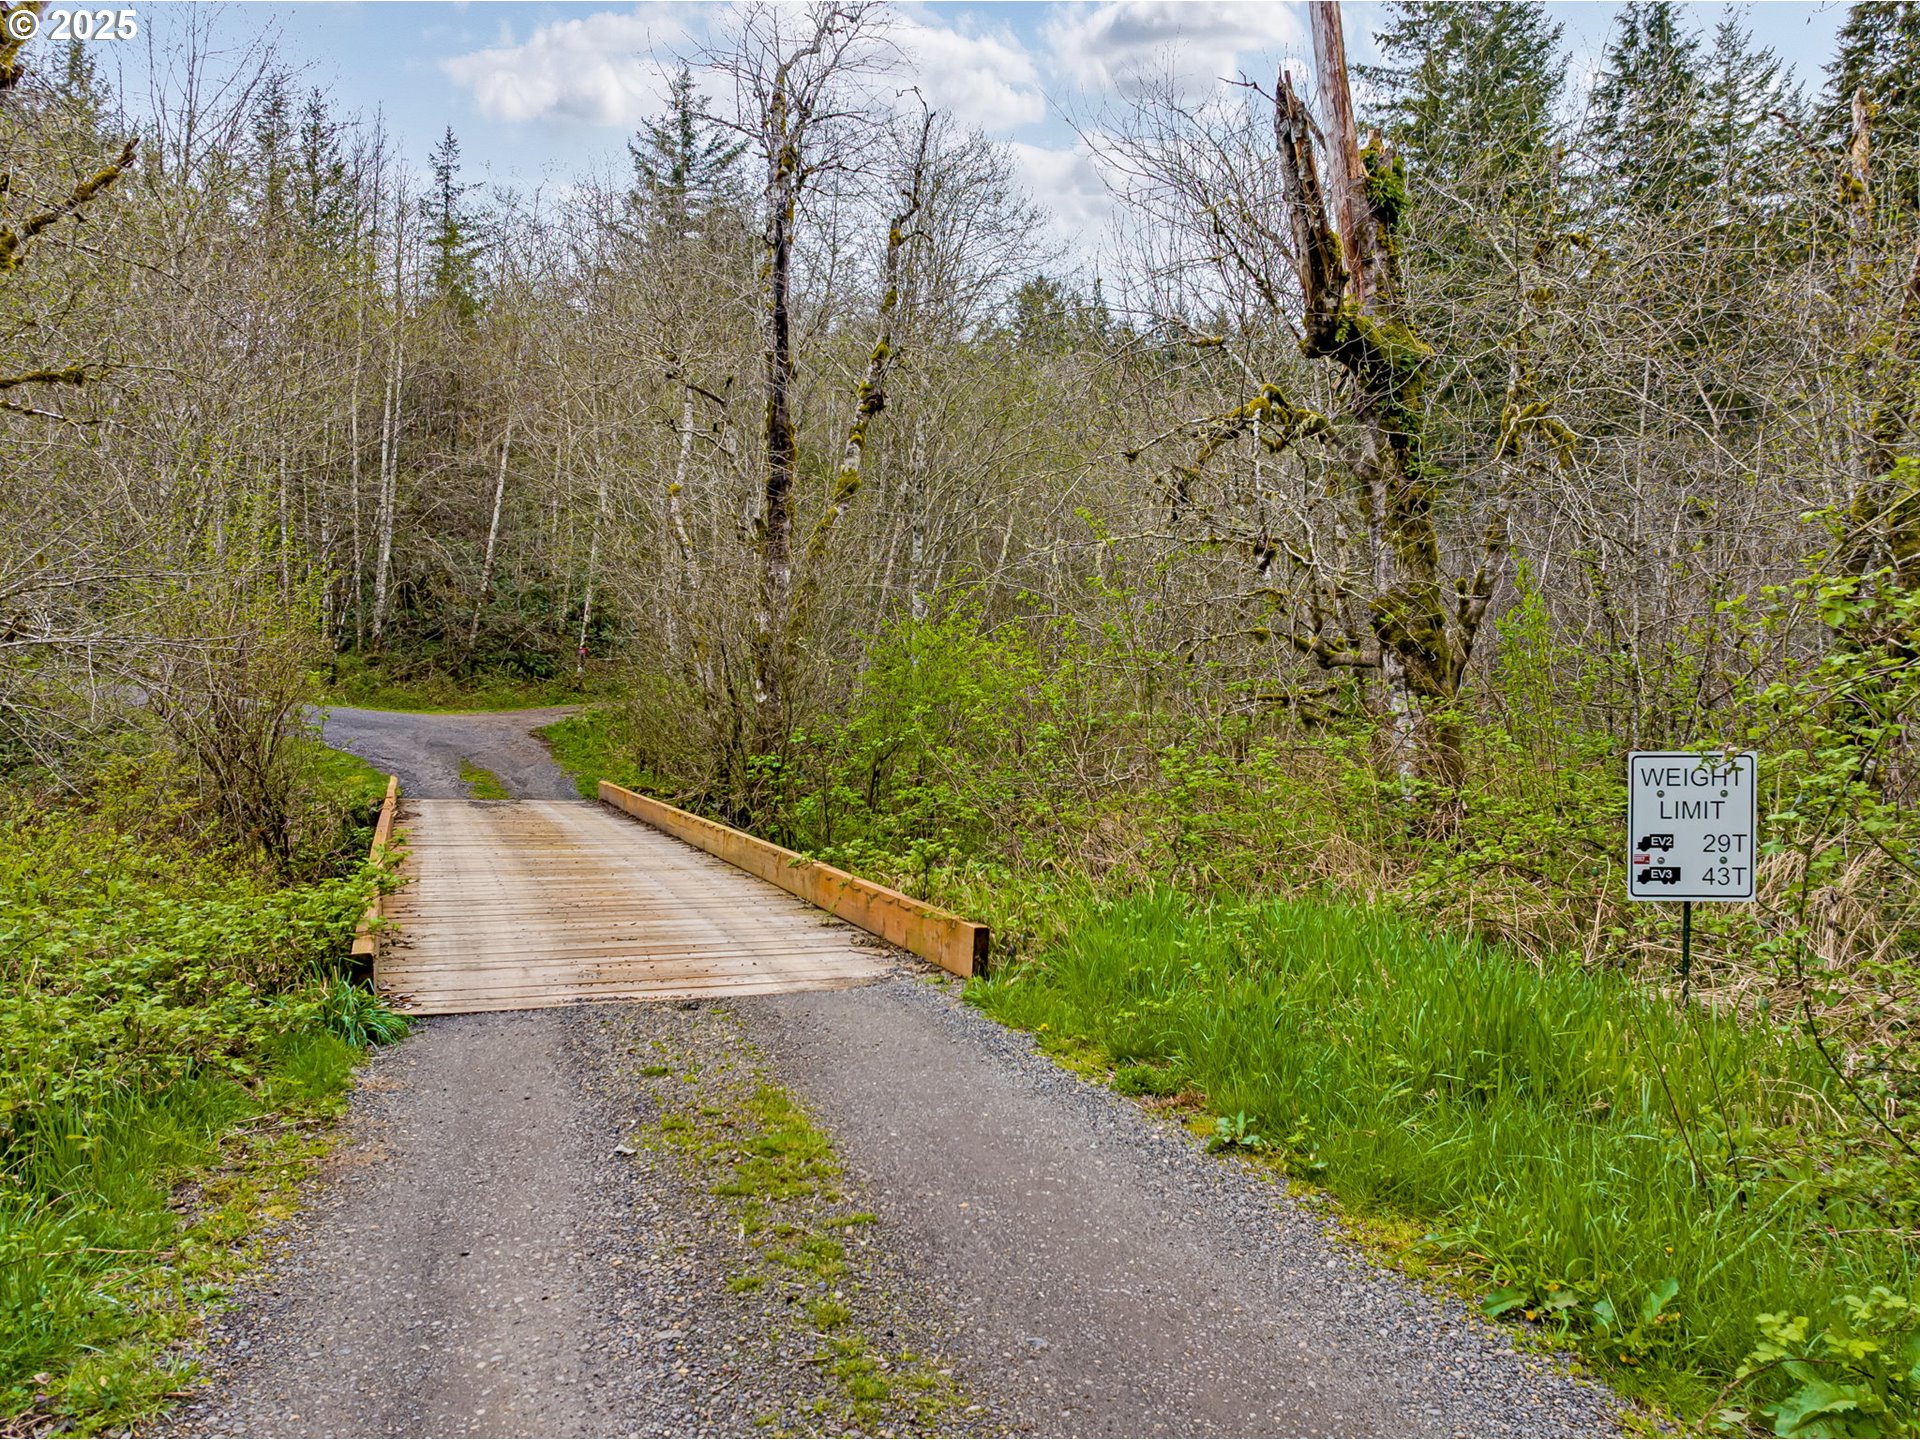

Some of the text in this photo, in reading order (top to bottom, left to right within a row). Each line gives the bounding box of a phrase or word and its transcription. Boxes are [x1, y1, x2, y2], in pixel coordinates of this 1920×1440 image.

[1641, 768, 1742, 787] WEIGHT
[1660, 801, 1725, 819] LIMIT
[1651, 834, 1747, 852] EV2 29T
[1651, 867, 1747, 885] EV3 43T
